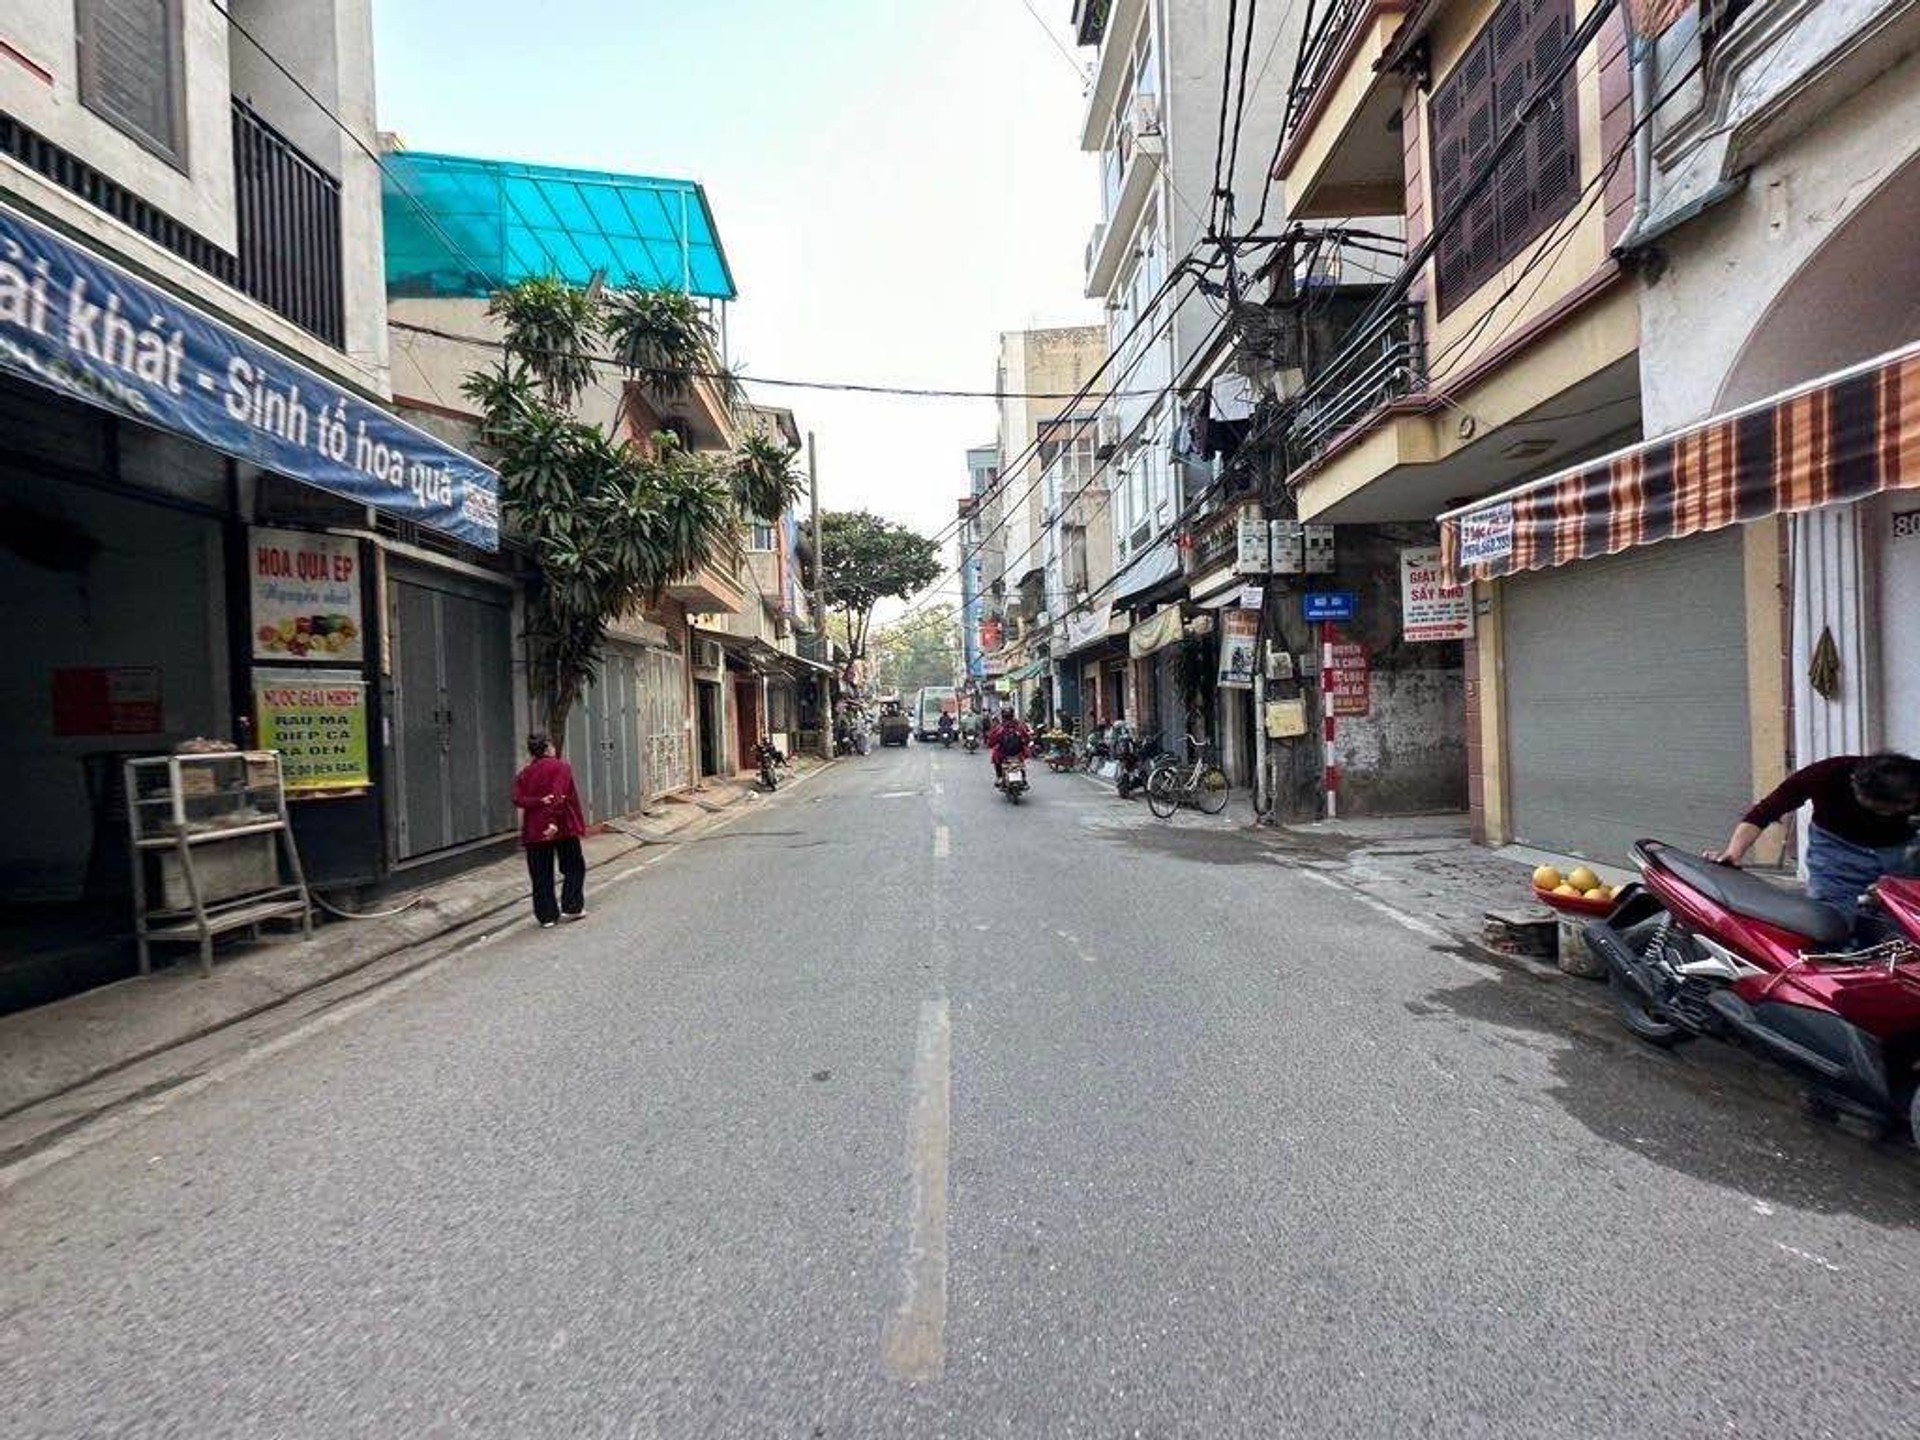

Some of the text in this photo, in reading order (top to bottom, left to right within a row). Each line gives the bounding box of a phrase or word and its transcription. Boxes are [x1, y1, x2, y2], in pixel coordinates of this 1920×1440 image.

[66, 275, 188, 396] khát
[225, 356, 308, 447] Sinh
[317, 396, 349, 463] tố
[355, 420, 407, 487] hoa
[257, 547, 294, 578] HOA
